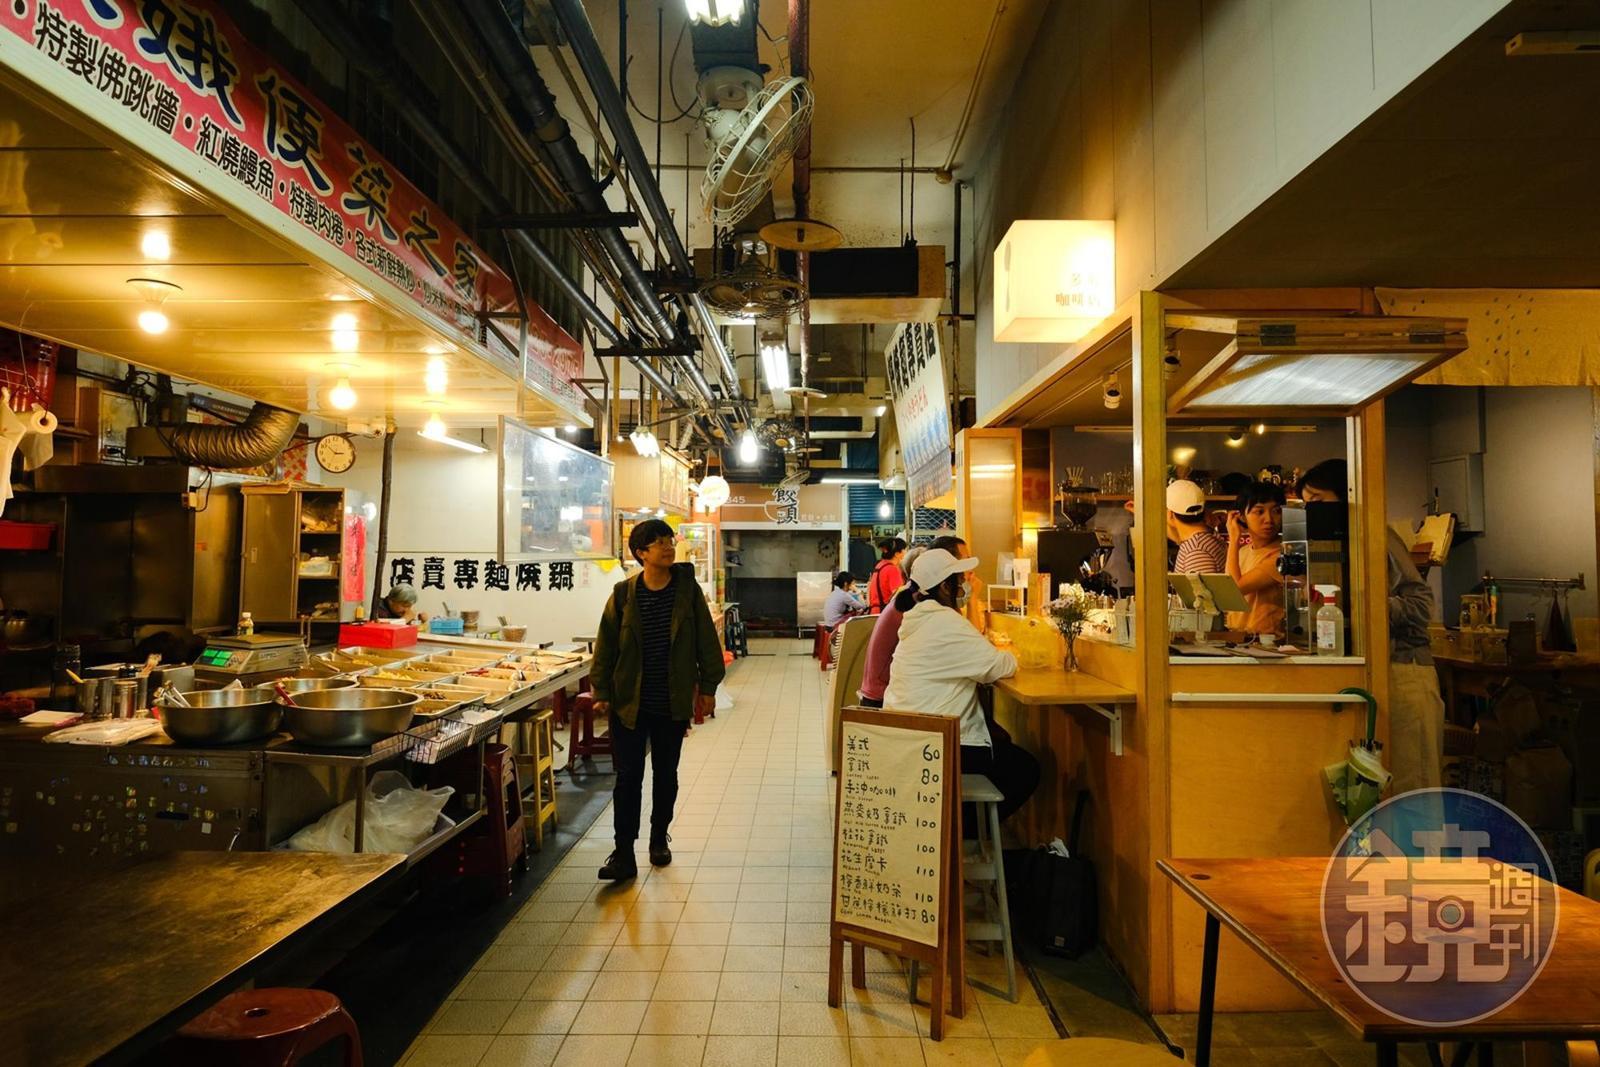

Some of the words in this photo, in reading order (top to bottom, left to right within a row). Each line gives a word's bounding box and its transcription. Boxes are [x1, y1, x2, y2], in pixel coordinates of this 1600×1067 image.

[36, 2, 180, 135] 特製佛跳牆
[196, 116, 275, 200] 紅燒鰻魚
[355, 230, 415, 292] 各式新鮮熱炒
[90, 0, 478, 301] 娥便菜之家
[847, 735, 869, 751] 美式
[923, 744, 940, 761] 60
[847, 757, 870, 772] 拿鐵
[921, 768, 939, 785] 80
[844, 801, 907, 825] 燕麥奶拿鐵
[916, 817, 936, 829] 100
[916, 844, 935, 853] 100
[841, 849, 887, 872] 花生摩卡
[916, 866, 935, 877] 110
[915, 892, 933, 903] 110
[921, 909, 935, 923] 80
